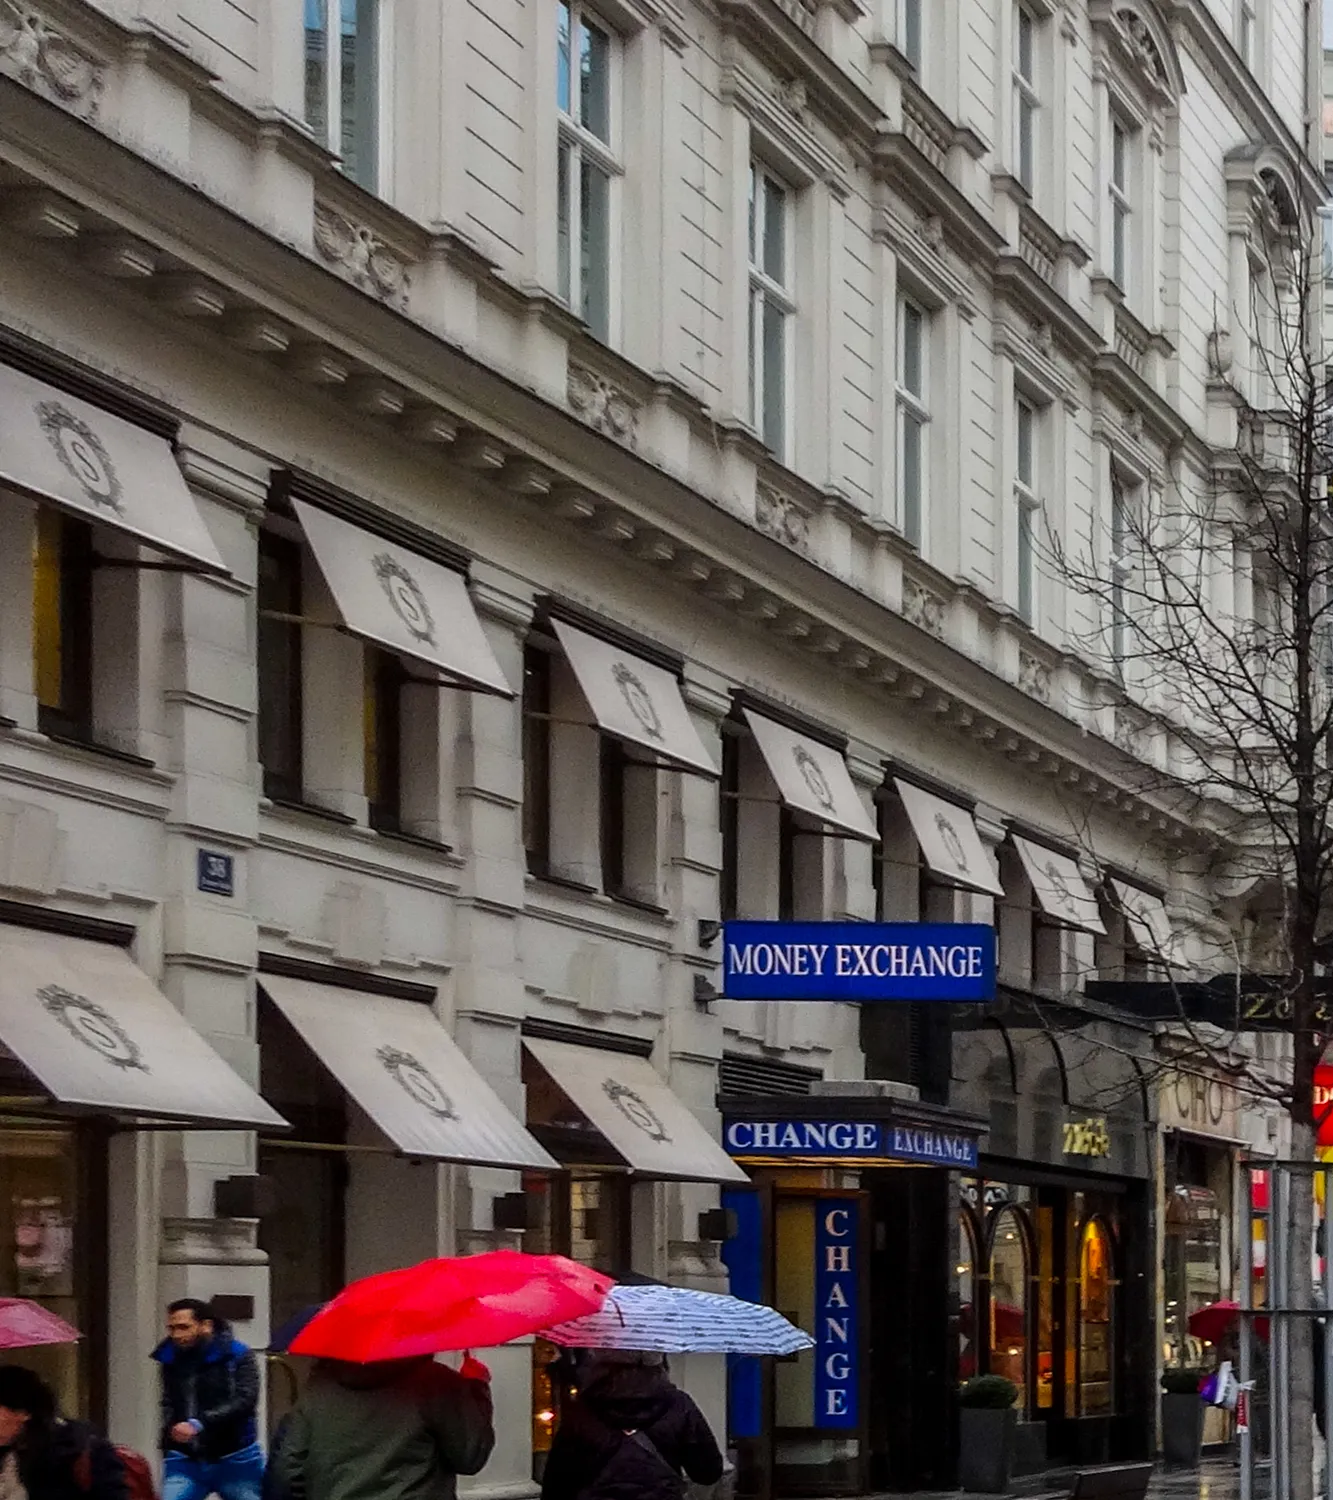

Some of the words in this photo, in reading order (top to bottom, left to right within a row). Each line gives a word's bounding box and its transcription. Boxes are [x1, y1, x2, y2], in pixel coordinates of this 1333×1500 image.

[728, 943, 830, 978] MONEY
[834, 944, 983, 979] EXCHANGE
[726, 1121, 878, 1150] CHANGE
[893, 1126, 973, 1163] EXCHANGE
[824, 1208, 852, 1418] CHANGE
